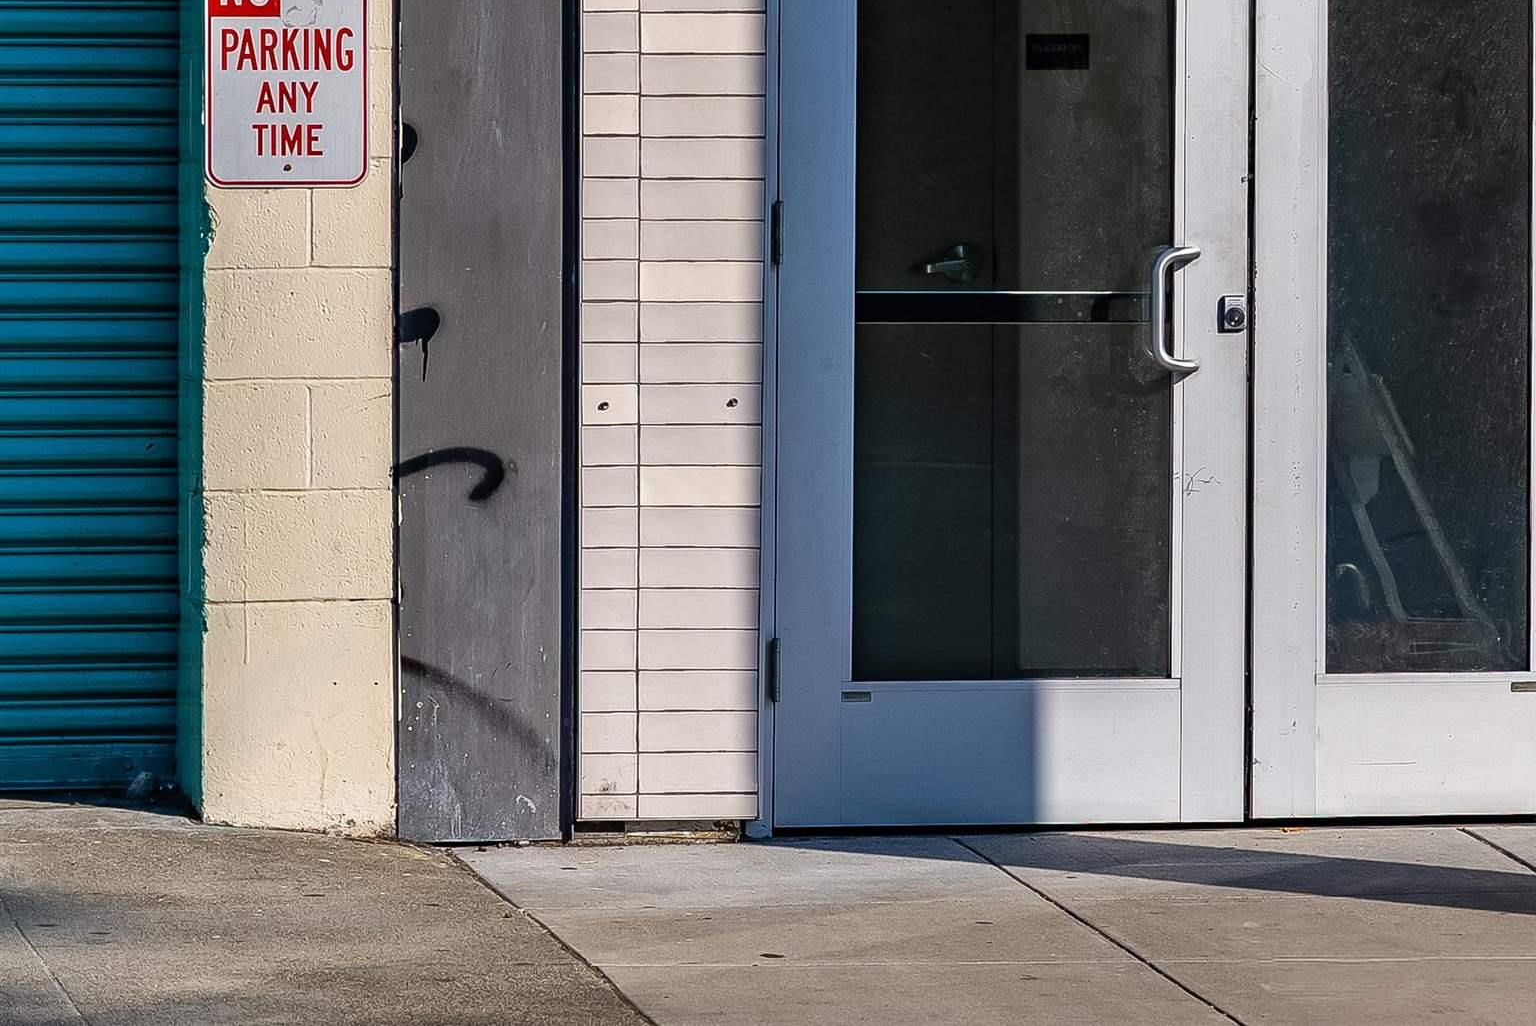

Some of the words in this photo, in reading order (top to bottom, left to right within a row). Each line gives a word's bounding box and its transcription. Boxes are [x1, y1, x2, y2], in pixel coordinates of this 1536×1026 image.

[220, 27, 355, 72] PARKING
[256, 81, 319, 114] ANY
[252, 124, 324, 157] TIME
